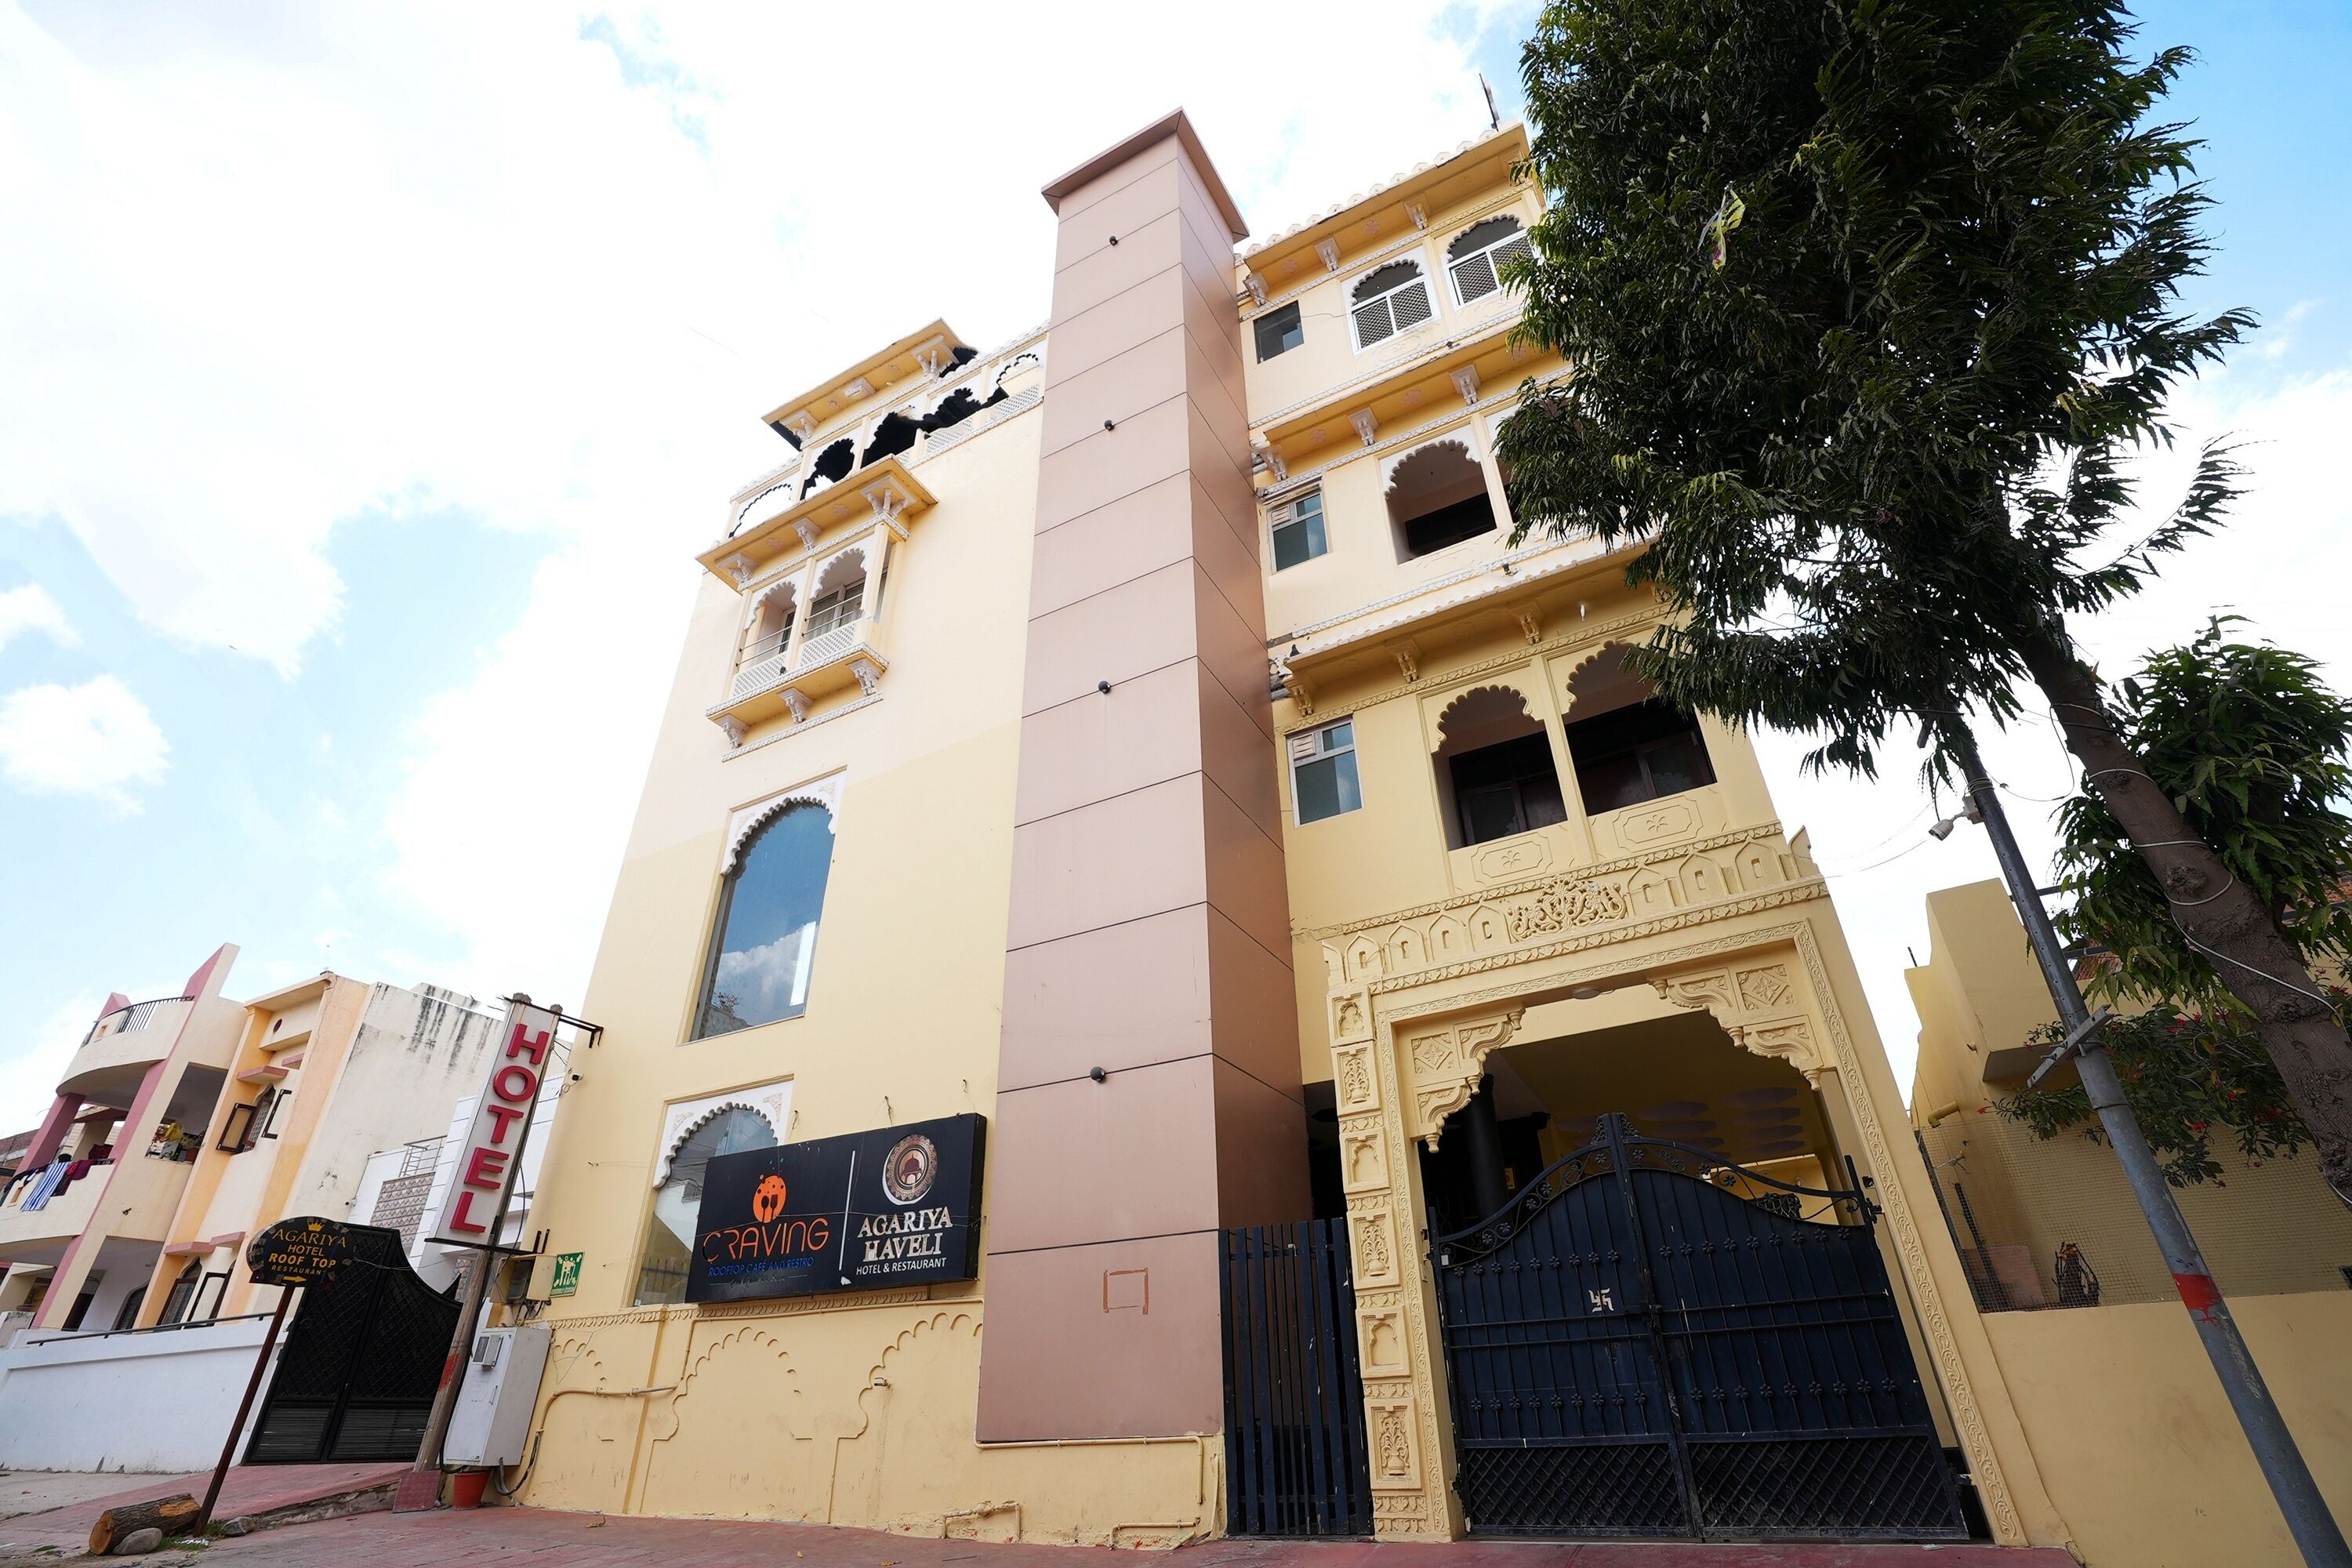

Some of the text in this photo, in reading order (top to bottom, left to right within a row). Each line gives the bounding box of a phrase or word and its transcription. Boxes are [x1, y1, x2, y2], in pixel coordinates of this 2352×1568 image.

[449, 1023, 550, 1233] HOTEL
[857, 1206, 953, 1238] AGARIYA
[272, 1229, 347, 1248] AGARIYA
[702, 1217, 829, 1264] CRAVING
[863, 1232, 943, 1262] HAVELI
[287, 1244, 325, 1257] HOTEL
[268, 1253, 337, 1269] ROOF TOP
[708, 1257, 815, 1277] ROOFTOP CAFÉ AND RESTRO
[856, 1257, 947, 1276] HOTEL & RESTAURANT
